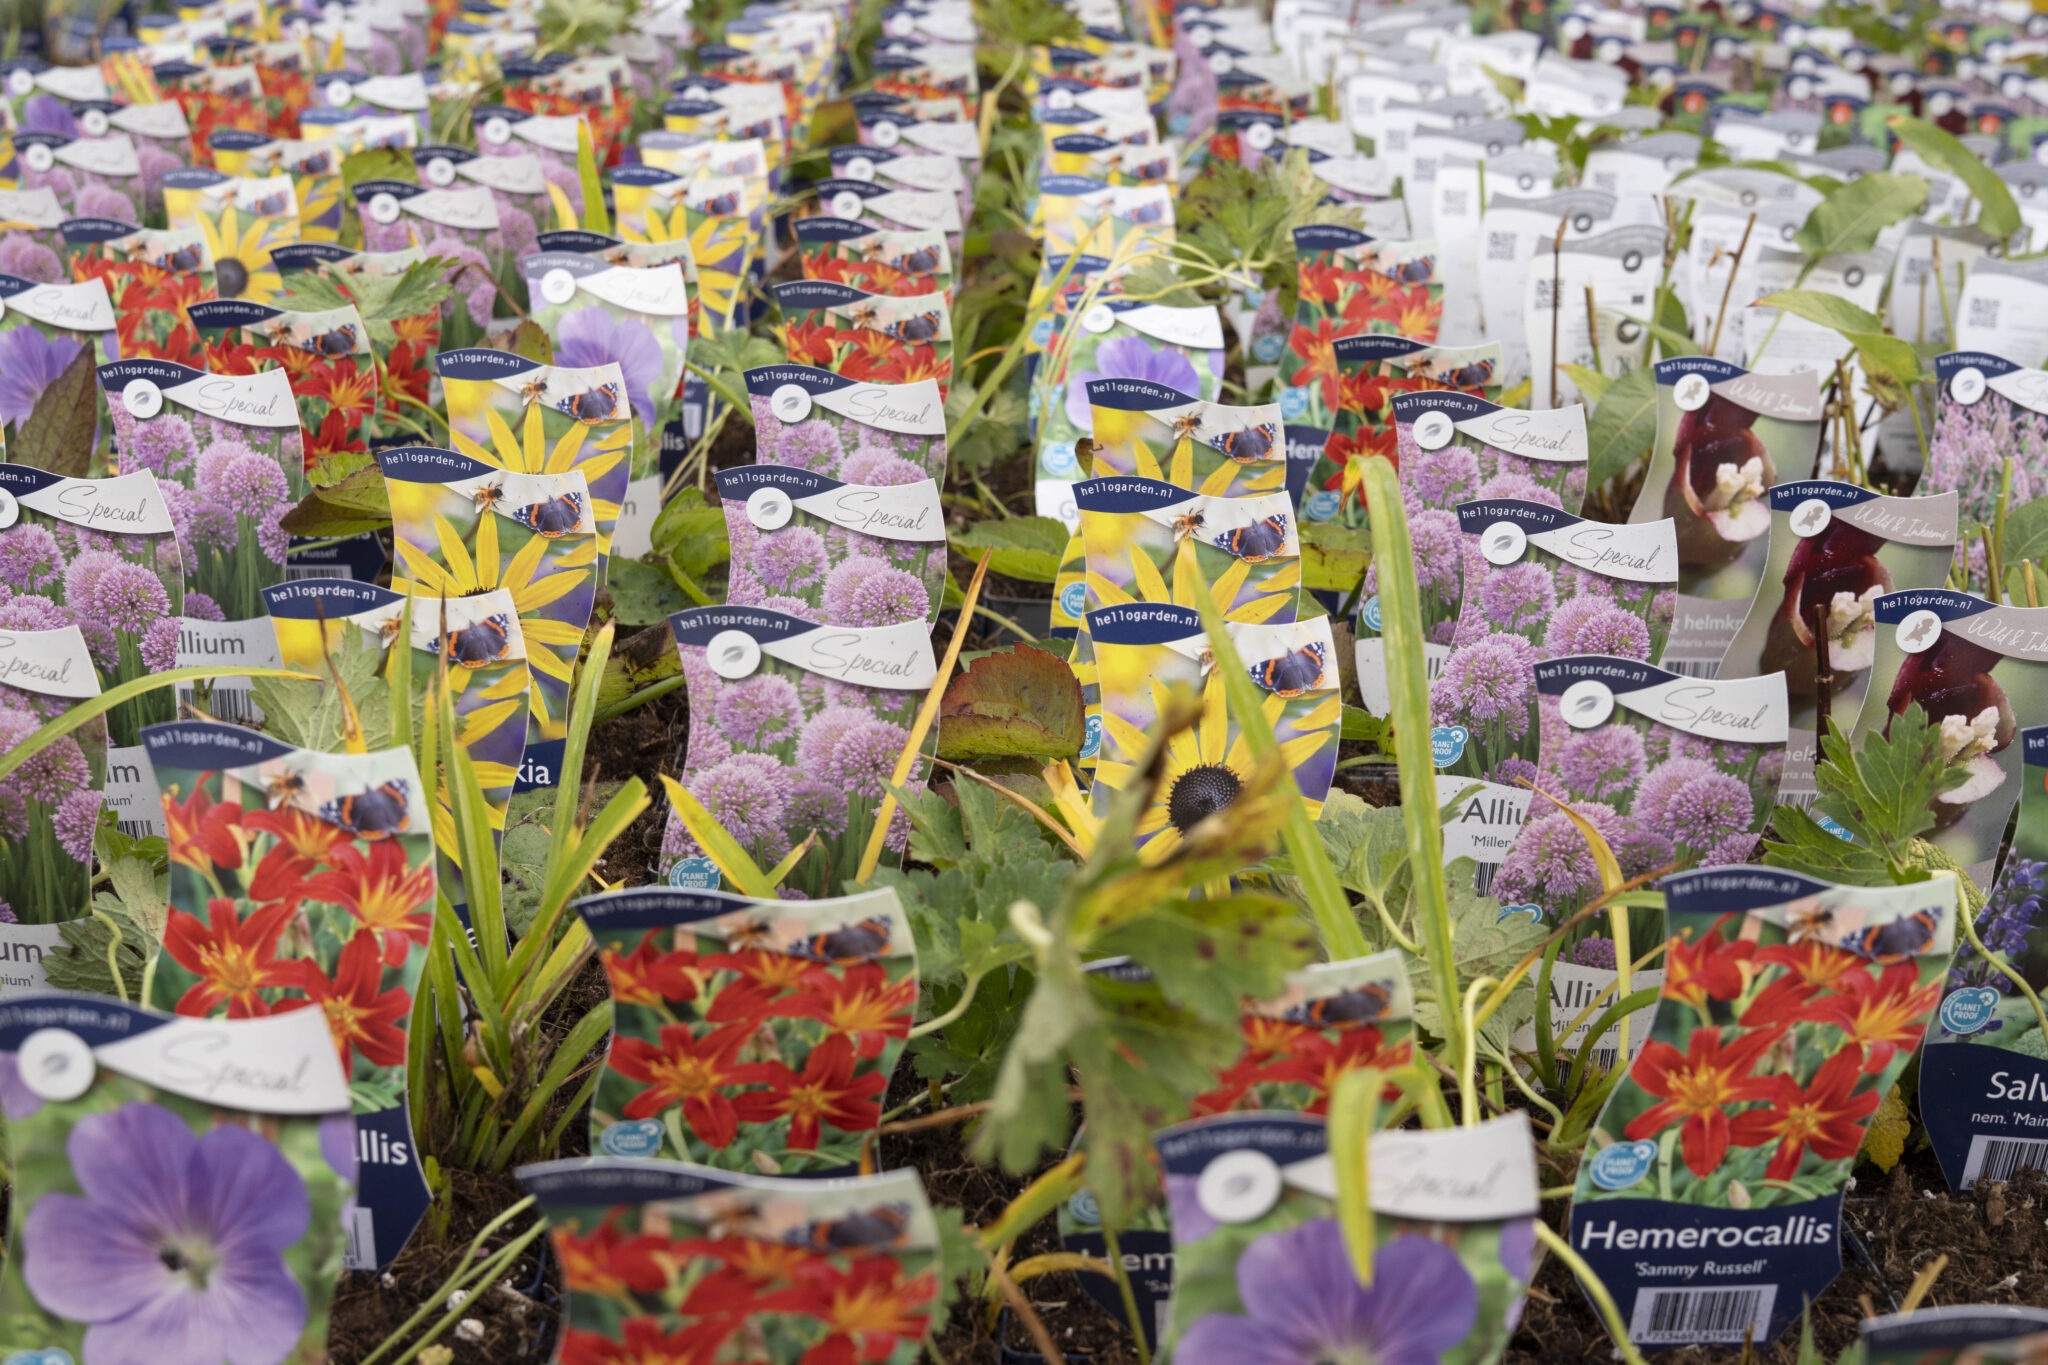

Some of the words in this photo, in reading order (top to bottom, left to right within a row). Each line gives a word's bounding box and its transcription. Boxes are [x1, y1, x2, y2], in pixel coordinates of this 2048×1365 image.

[780, 285, 853, 300] hellogarden.nl
[32, 289, 97, 323] Special
[193, 306, 265, 318] hellogarden.nl
[442, 354, 521, 368] hellogarden.nl
[1660, 362, 1732, 376] hellogarden.nl
[102, 366, 182, 380] hellogarden.nl
[752, 371, 834, 385] hellogarden.nl
[199, 381, 278, 417] Special
[1093, 382, 1176, 401] hellogarden.nl
[848, 388, 932, 424] Special
[1396, 398, 1479, 413] hellogarden.nl
[1489, 415, 1573, 452] Special
[386, 453, 473, 471] hellogarden.nl
[725, 473, 819, 488] hellogarden.nl
[1081, 482, 1173, 499] hellogarden.nl
[1777, 487, 1859, 500] hellogarden.nl
[58, 485, 147, 523] Special
[835, 491, 929, 530] Special
[1462, 507, 1556, 524] hellogarden.nl
[1566, 528, 1661, 571] Special
[271, 586, 377, 602] hellogarden.nl
[1882, 596, 1973, 611] hellogarden.nl
[681, 614, 790, 631] hellogarden.nl
[1096, 610, 1199, 628] hellogarden.nl
[177, 630, 245, 655] llium
[809, 634, 919, 677] Special
[1540, 664, 1648, 682] hellogarden.nl
[1660, 686, 1769, 731] Special
[150, 728, 264, 753] hellogarden.nl
[1432, 740, 1454, 748] PLANET
[1432, 747, 1453, 755] PROOF
[681, 872, 709, 880] PLANET
[683, 880, 708, 888] PROOF
[1952, 1010, 1980, 1021] PROOF
[1953, 1002, 1983, 1013] PLANET
[160, 1031, 312, 1096] Special
[1971, 1112, 2008, 1125] nem.
[1580, 1215, 1833, 1250] Hemerocallis
[1634, 1261, 1699, 1279] 'Sammy
[1703, 1259, 1768, 1276] Russell'
